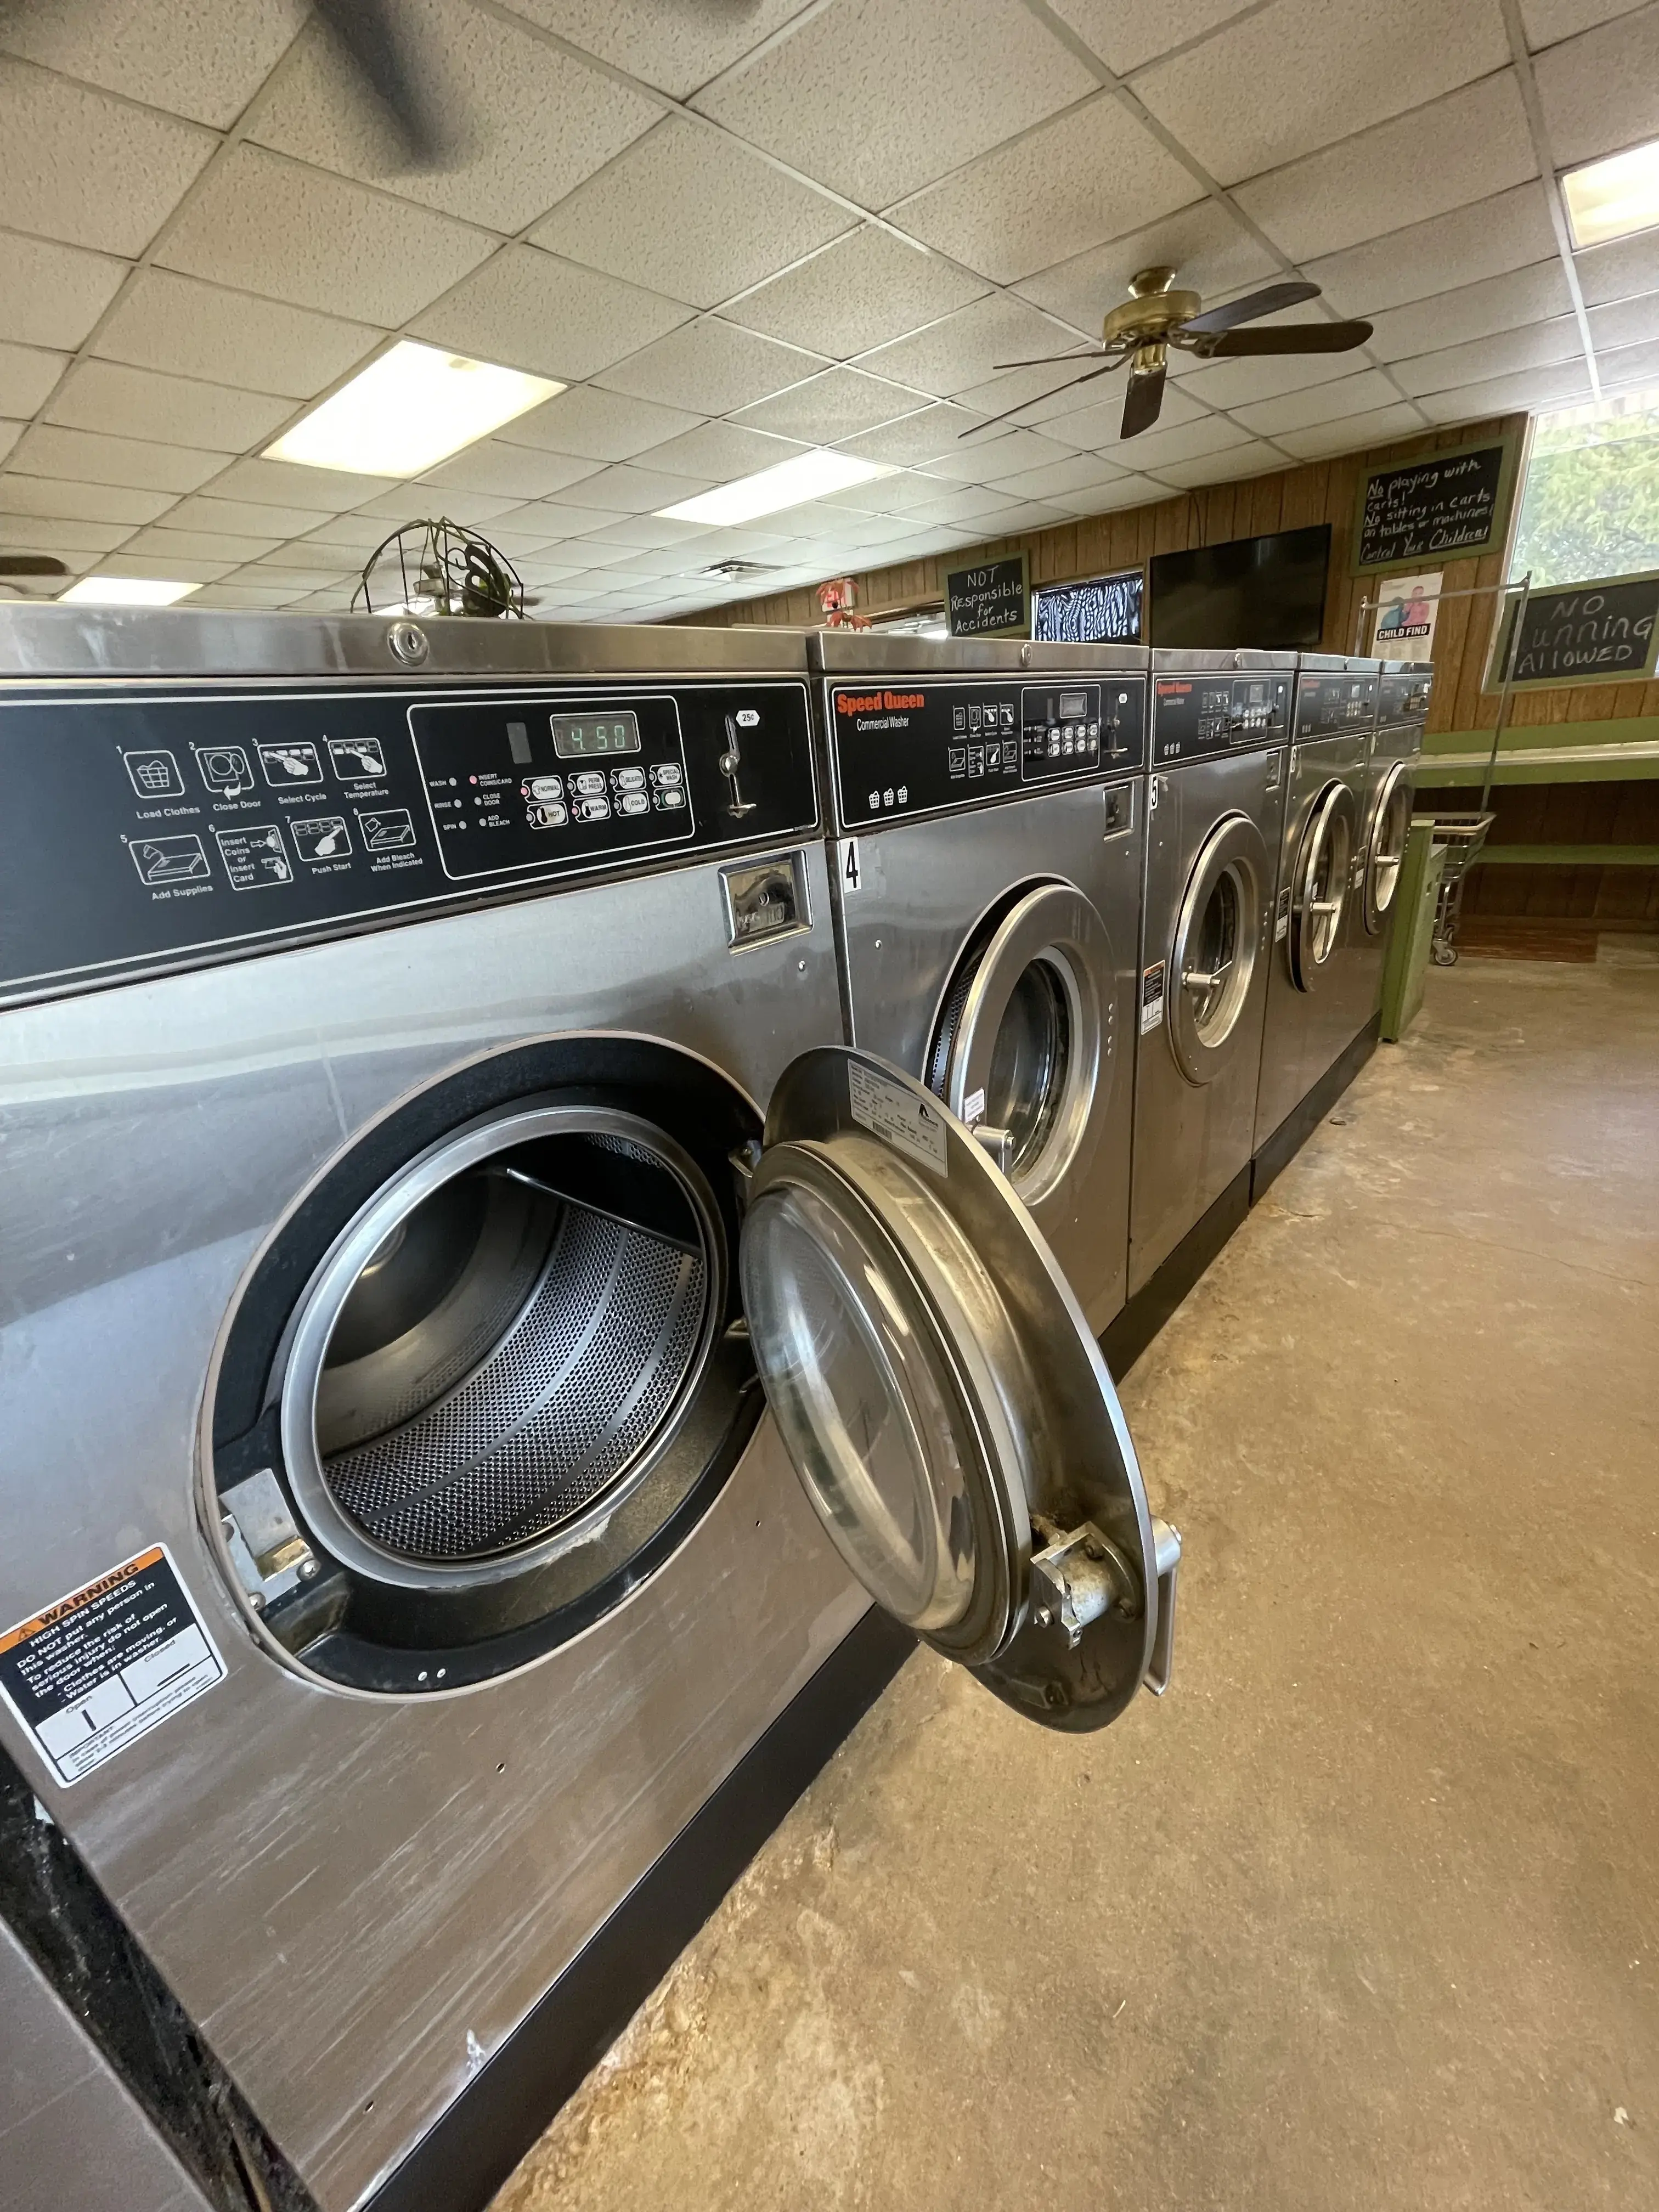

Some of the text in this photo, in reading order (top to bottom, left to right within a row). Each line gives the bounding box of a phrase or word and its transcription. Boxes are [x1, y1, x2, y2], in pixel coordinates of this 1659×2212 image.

[1367, 459, 1482, 500] No playing with
[1364, 488, 1490, 527] No sitting in carts
[1379, 522, 1414, 538] tables
[967, 565, 999, 588] NOT
[978, 603, 994, 617] for
[1550, 595, 1605, 620] NO
[1379, 625, 1427, 640] CHILD FIND
[837, 691, 924, 716] Speed Queen
[856, 715, 909, 731] Commercial Washer
[252, 738, 258, 747] 3
[322, 734, 328, 742] 4
[116, 745, 122, 754] 1
[188, 742, 196, 751] 2
[343, 788, 389, 799] Temperature
[353, 782, 376, 790] Select
[541, 784, 560, 792] NORMAL
[213, 800, 262, 811] Close Door
[278, 793, 328, 805] Select Cycle
[136, 806, 201, 819] Load Clothes
[208, 824, 216, 833] 6
[120, 834, 128, 843] 5
[221, 837, 247, 847] Insert
[224, 847, 251, 856] Coins
[376, 852, 415, 864] Add Bleach
[230, 863, 255, 873] Insert
[312, 862, 351, 875] Push Start
[370, 858, 423, 872] When Indicated
[845, 841, 859, 889] 4
[233, 873, 254, 883] Card
[152, 884, 213, 900] Add Supplies
[38, 1563, 139, 1626] WARNING
[29, 1580, 137, 1647] HIGH SPIN SPEEDS
[16, 1581, 155, 1669] DO NOT put any person in
[20, 1633, 88, 1674] this washer.
[26, 1613, 136, 1684] To reduce the risk of
[31, 1603, 168, 1691] serious injury do not open
[64, 1664, 105, 1692] Clothes
[107, 1652, 124, 1666] are
[166, 1617, 177, 1627] or
[144, 1639, 176, 1662] Closed
[35, 1685, 54, 1698] the
[56, 1667, 82, 1685] door
[65, 1677, 97, 1700] Water
[100, 1669, 110, 1678] is
[111, 1662, 122, 1672] in
[66, 1695, 93, 1713] Open
